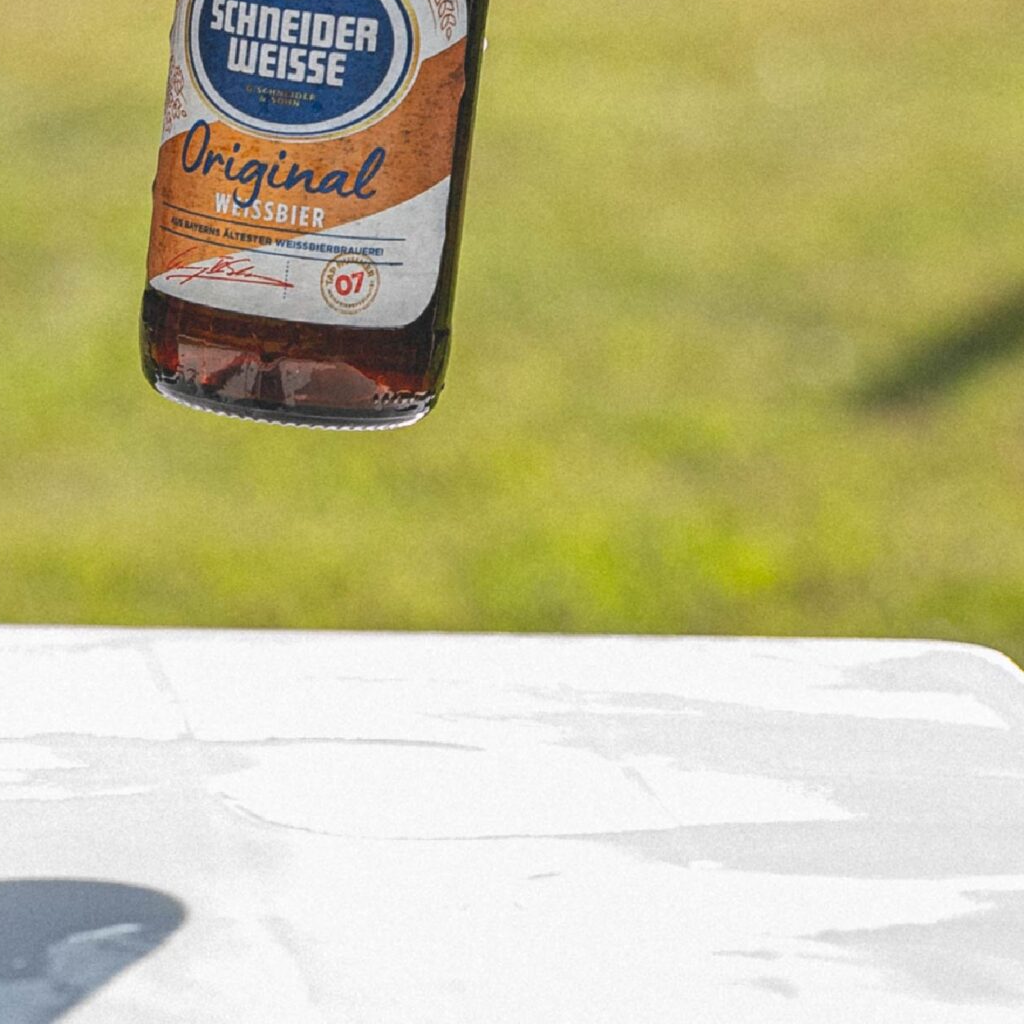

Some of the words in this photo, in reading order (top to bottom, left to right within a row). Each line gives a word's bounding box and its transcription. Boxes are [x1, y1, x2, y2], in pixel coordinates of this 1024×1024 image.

[227, 36, 347, 87] WEISSE
[182, 119, 386, 208] Original
[215, 192, 325, 228] WEISSBIER
[223, 228, 273, 246] ÄLTESTER
[276, 239, 384, 256] WEISSBIERBRAUEREI
[335, 272, 364, 296] 07
